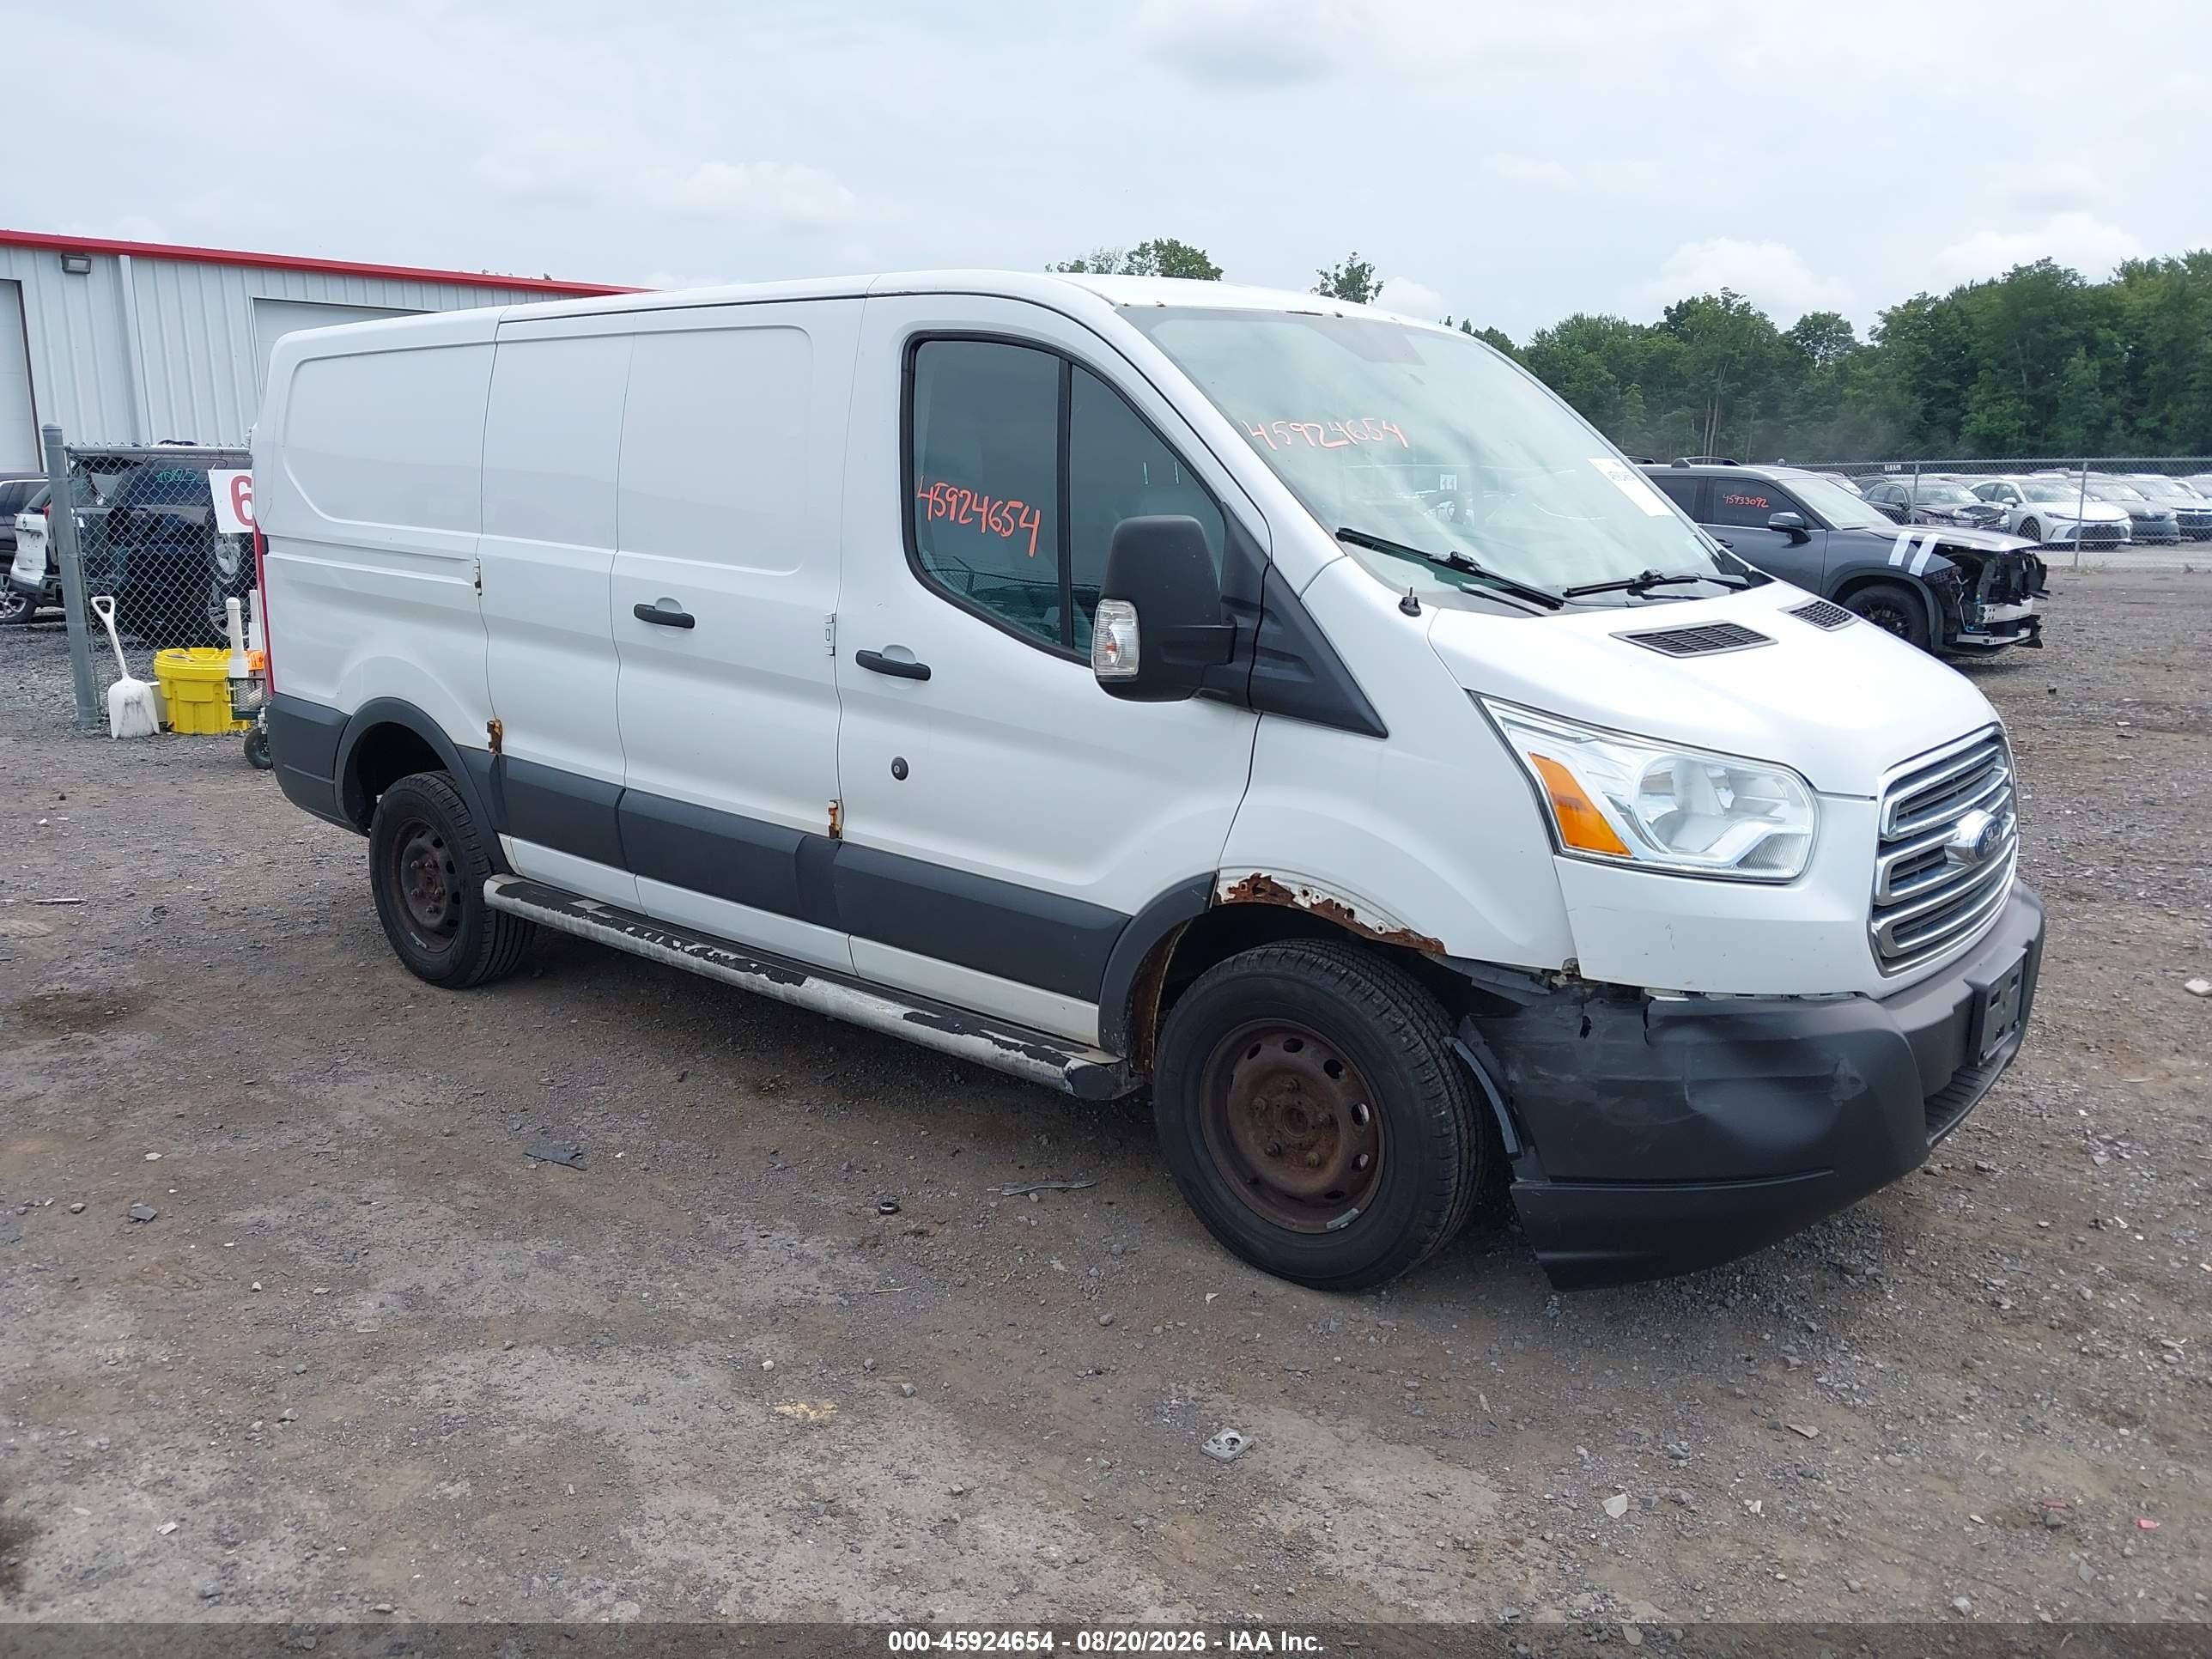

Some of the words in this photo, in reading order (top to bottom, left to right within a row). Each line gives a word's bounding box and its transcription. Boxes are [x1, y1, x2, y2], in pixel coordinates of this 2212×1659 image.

[1243, 419, 1408, 450] 45924654
[230, 475, 253, 526] 6
[917, 475, 1040, 557] 45924654
[1723, 493, 1769, 508] 45933092
